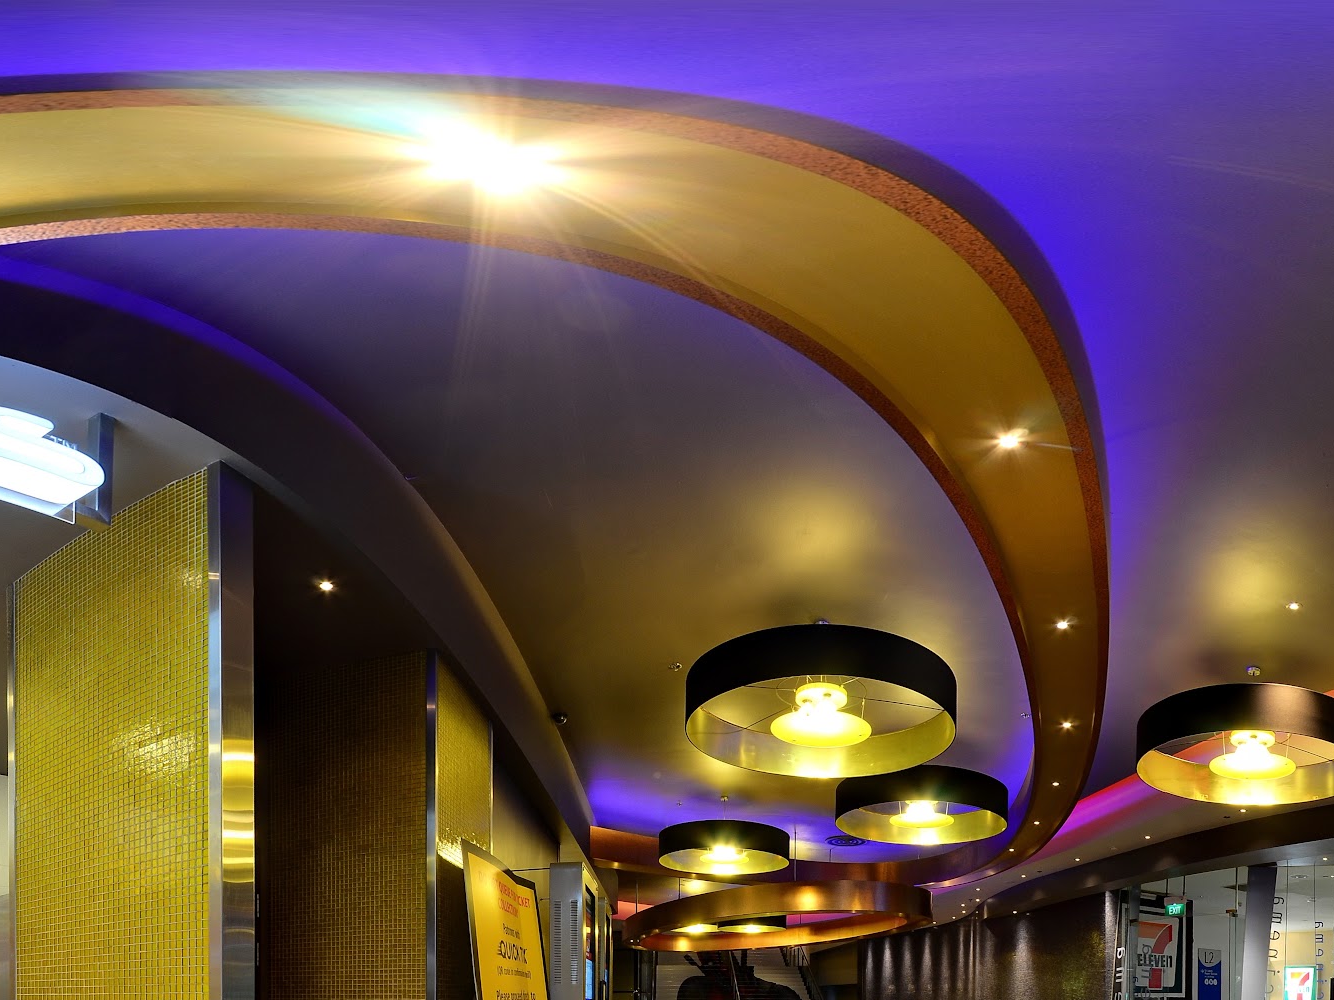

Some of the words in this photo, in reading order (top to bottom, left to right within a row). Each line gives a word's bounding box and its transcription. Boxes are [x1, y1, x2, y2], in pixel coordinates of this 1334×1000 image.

[1168, 905, 1182, 915] EXIT
[1204, 951, 1214, 963] L2
[531, 991, 536, 1000] to
